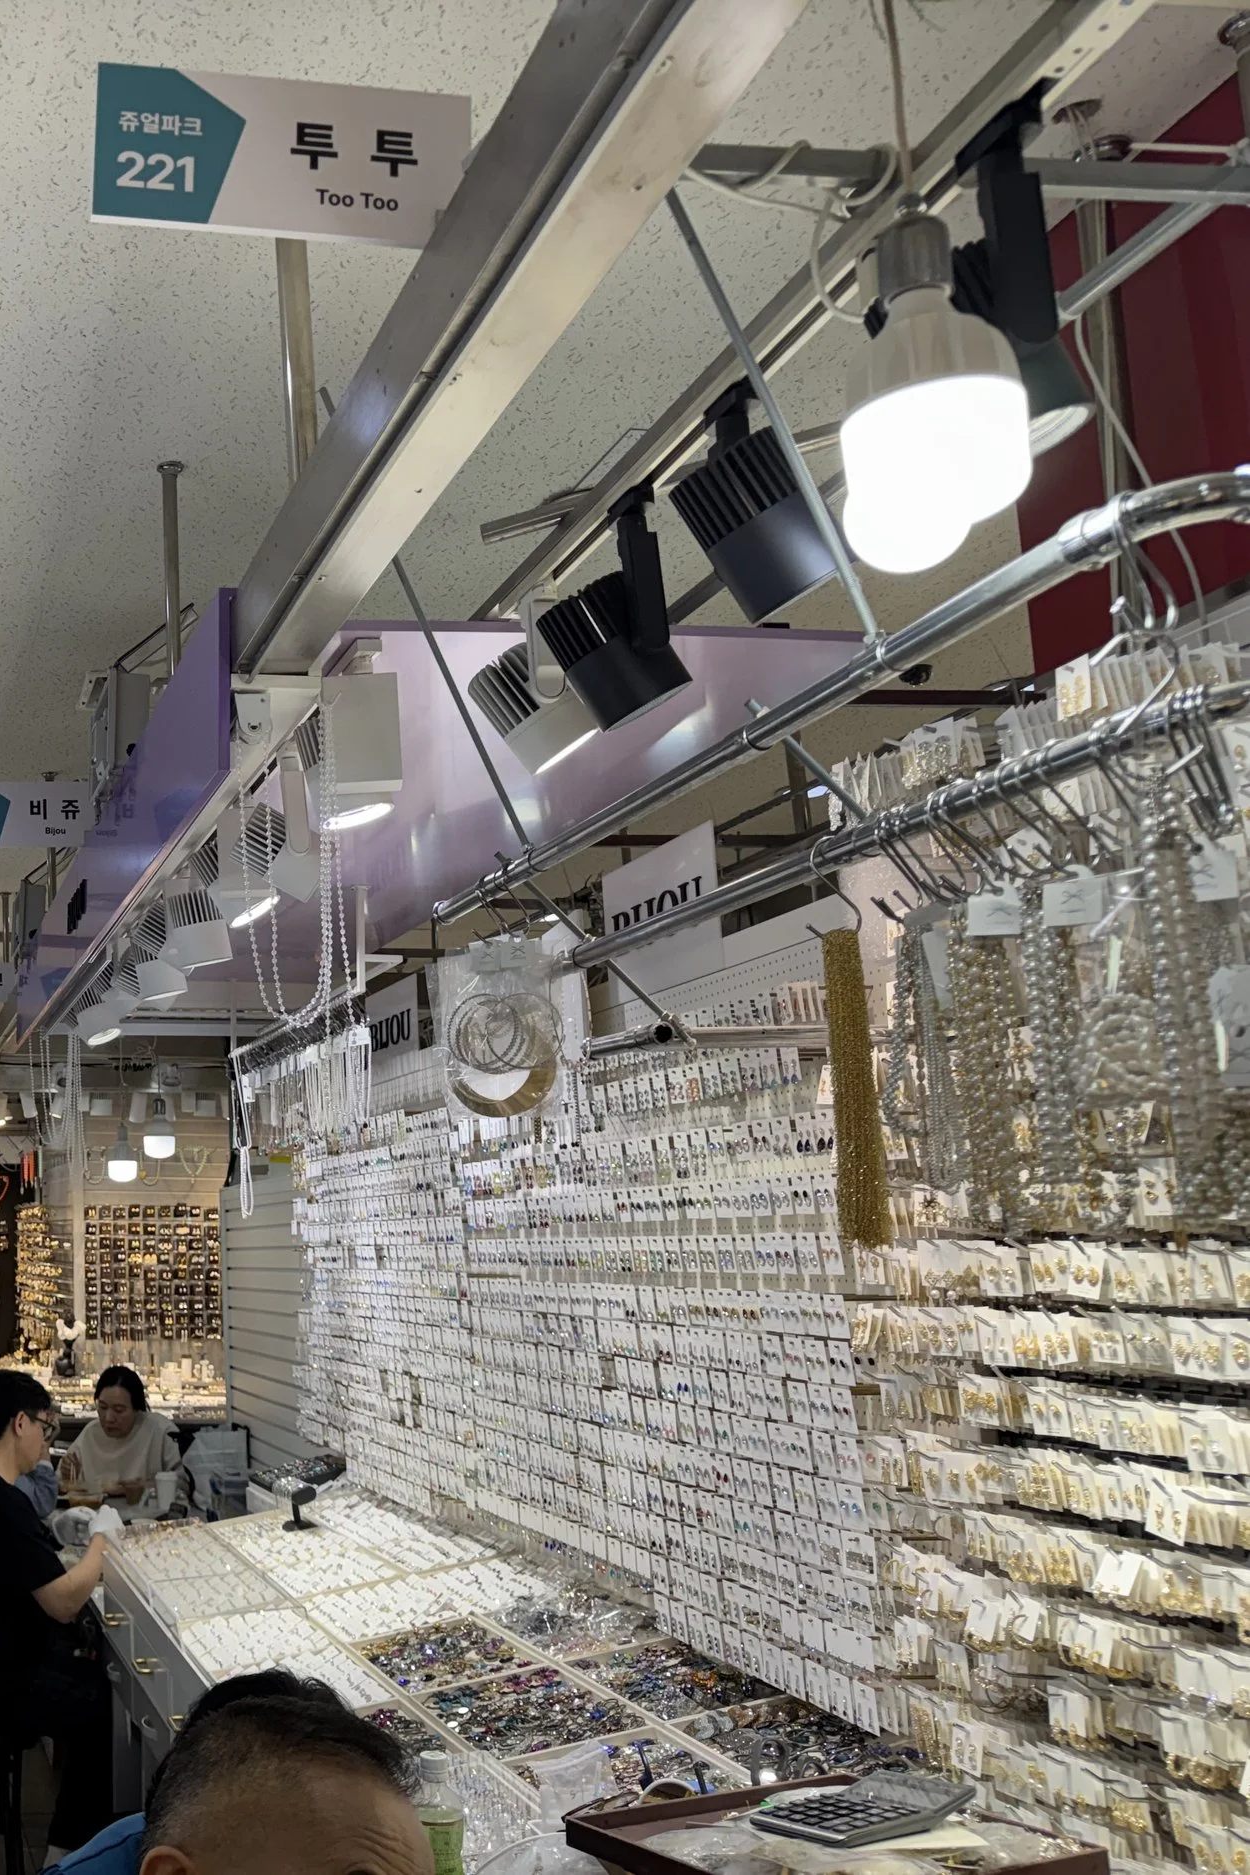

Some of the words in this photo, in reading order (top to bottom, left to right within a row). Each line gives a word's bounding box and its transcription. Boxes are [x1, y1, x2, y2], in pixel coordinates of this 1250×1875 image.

[118, 110, 203, 137] 쥬얼파크
[115, 149, 196, 193] 221
[315, 187, 355, 209] Too
[360, 191, 399, 212] Too
[45, 826, 67, 836] Bijou
[369, 1008, 411, 1052] BIJOU
